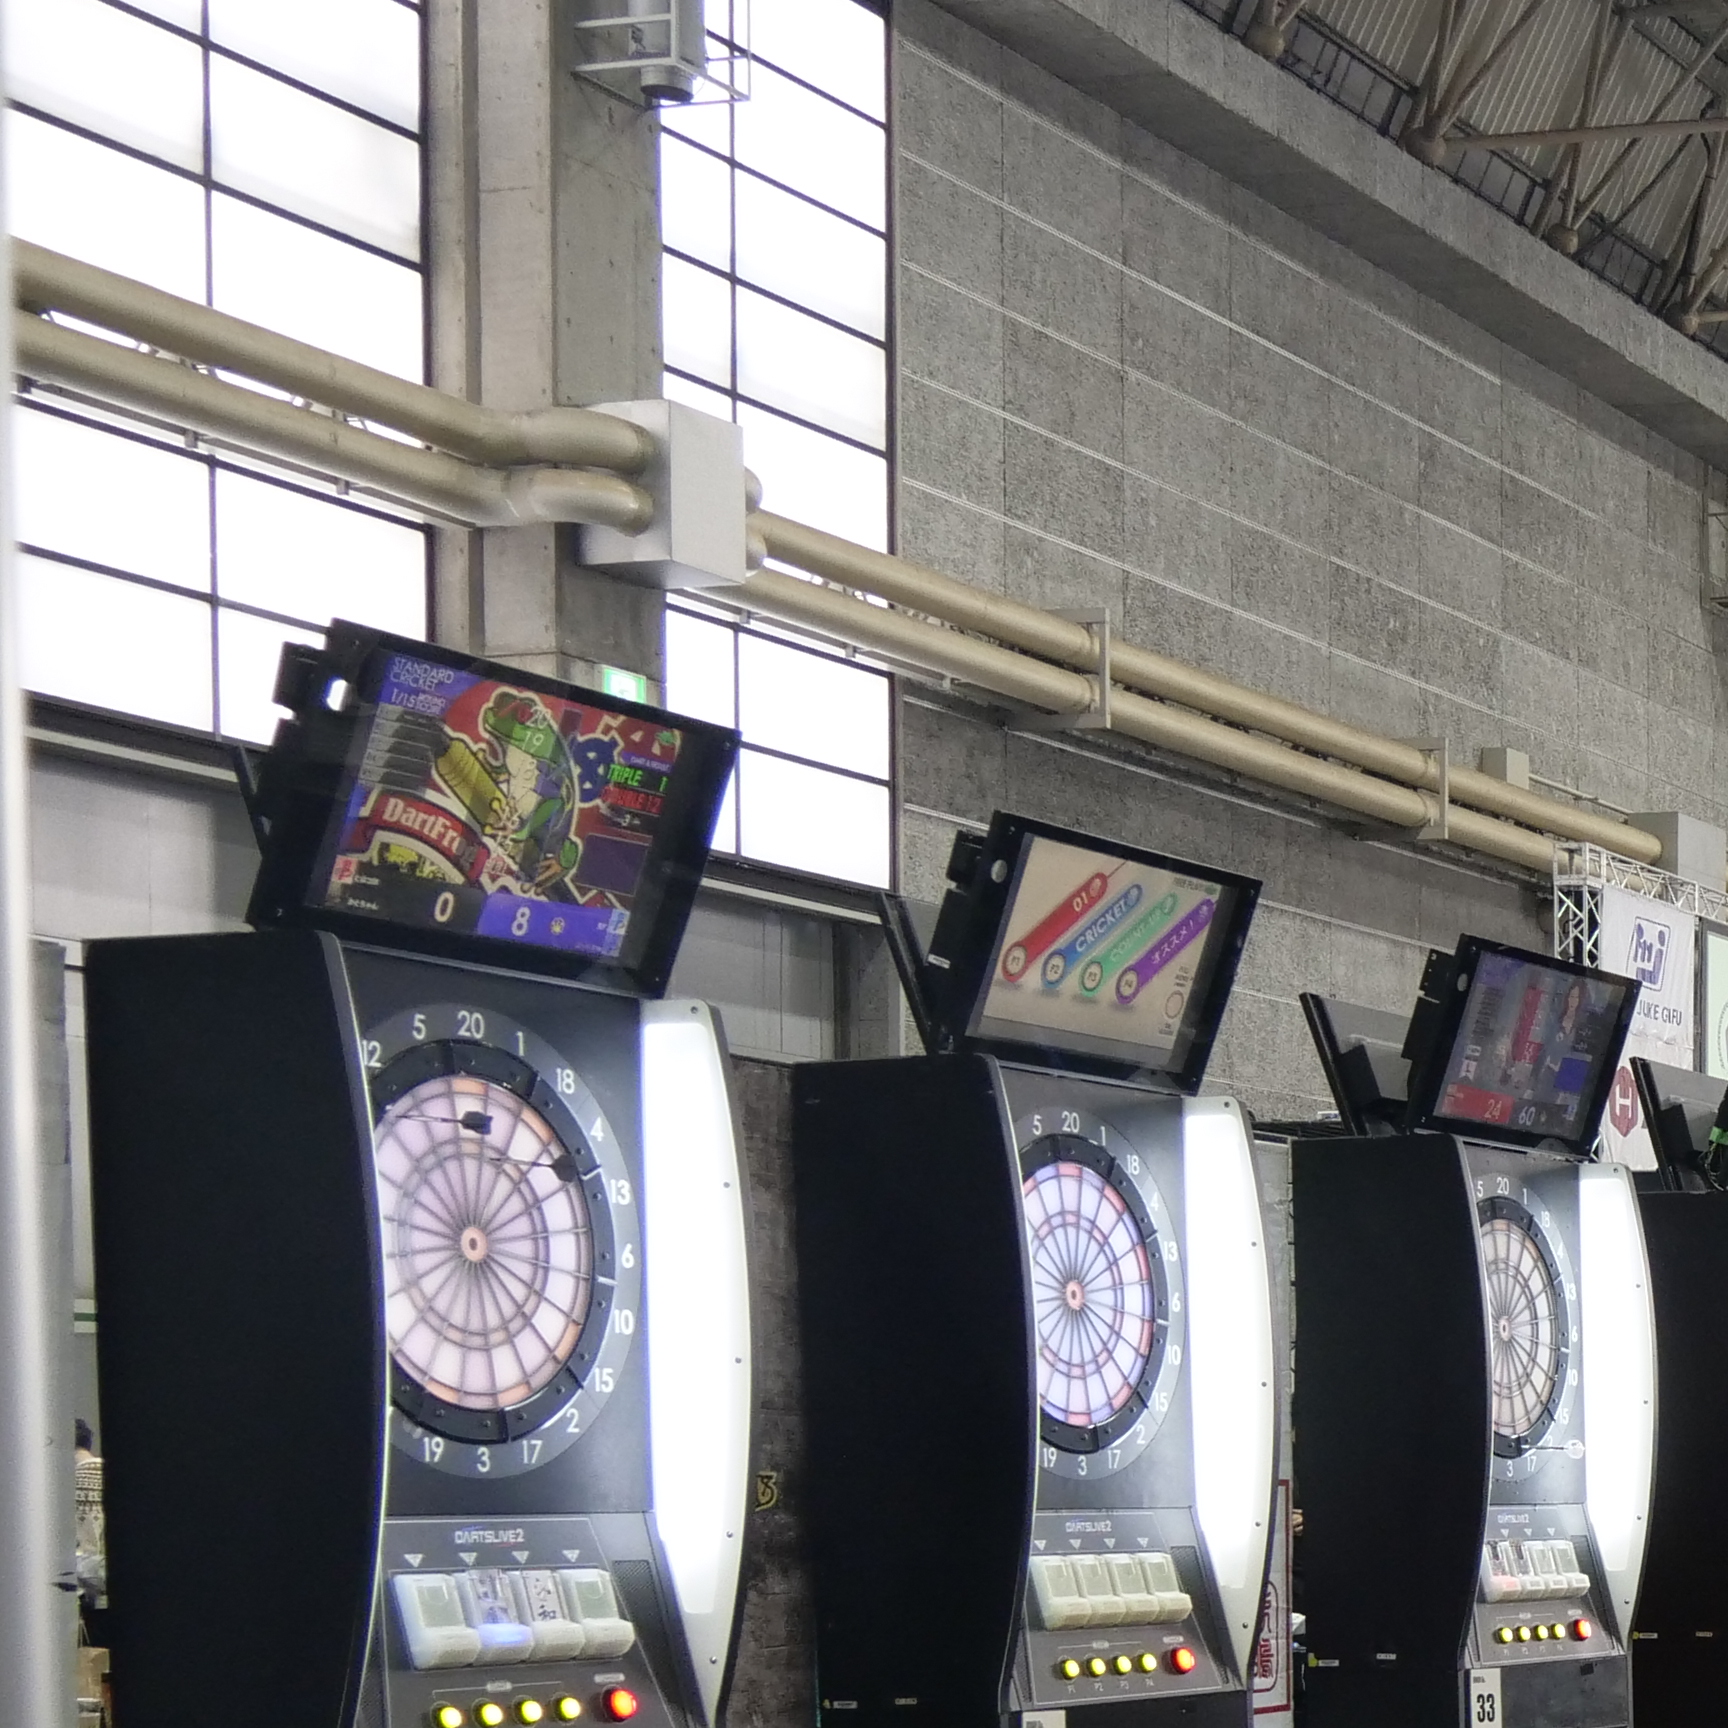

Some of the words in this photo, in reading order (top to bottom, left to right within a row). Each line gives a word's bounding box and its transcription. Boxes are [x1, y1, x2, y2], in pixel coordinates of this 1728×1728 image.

[392, 656, 455, 684] STANDARD
[607, 764, 643, 787] TRIPLE
[434, 891, 455, 922] 0
[1072, 893, 1089, 913] 01
[511, 906, 531, 936] 8
[1075, 900, 1129, 953] CRICKET
[1636, 999, 1660, 1021] JUKE
[1661, 1005, 1683, 1027] GIFU
[412, 1014, 427, 1040] 5
[457, 1012, 485, 1039] 20
[362, 1040, 382, 1068] 12
[515, 1032, 525, 1056] 1
[557, 1069, 576, 1094] 18
[1484, 1099, 1502, 1119] 24
[1518, 1105, 1535, 1127] 60
[590, 1117, 605, 1141] 4
[1033, 1116, 1043, 1136] 5
[1062, 1112, 1080, 1132] 20
[1099, 1126, 1106, 1146] 1
[1126, 1154, 1140, 1175] 18
[610, 1179, 631, 1205] 13
[1150, 1192, 1159, 1211] 4
[622, 1244, 635, 1269] 6
[1164, 1241, 1178, 1261] 13
[1172, 1292, 1181, 1312] 6
[614, 1310, 634, 1334] 10
[1167, 1345, 1181, 1365] 10
[595, 1369, 615, 1393] 15
[1155, 1393, 1168, 1412] 15
[567, 1410, 580, 1433] 2
[1136, 1426, 1146, 1445] 2
[423, 1438, 444, 1463] 19
[477, 1447, 490, 1473] 3
[523, 1440, 543, 1464] 17
[1043, 1448, 1057, 1468] 19
[1107, 1450, 1122, 1470] 17
[1078, 1456, 1087, 1476] 3
[454, 1528, 525, 1545] DARTSLIVE2
[1065, 1519, 1113, 1534] DARTSLIVE2
[1476, 1693, 1496, 1723] 33
